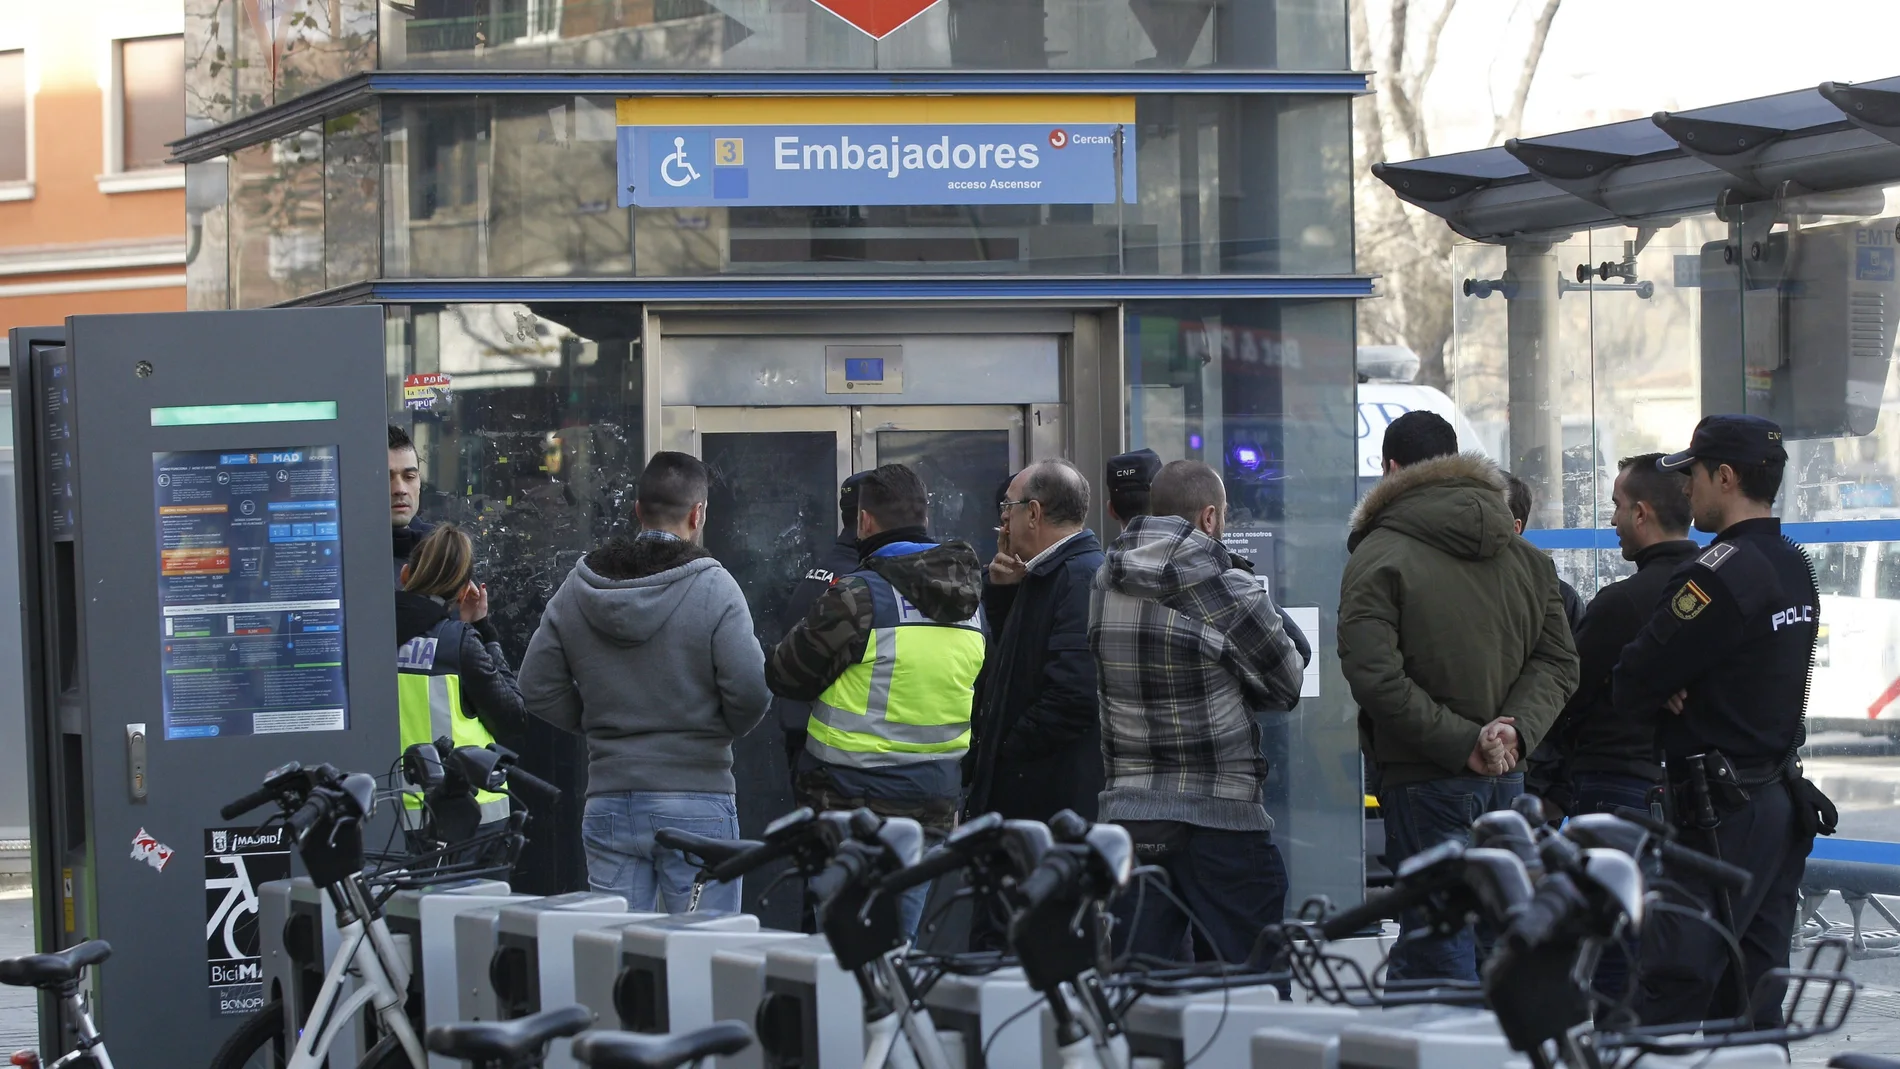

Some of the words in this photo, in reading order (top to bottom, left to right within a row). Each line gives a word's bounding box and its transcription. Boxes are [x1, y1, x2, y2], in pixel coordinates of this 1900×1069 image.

[1072, 133, 1126, 144] Cercans
[722, 140, 737, 163] 3
[774, 135, 1040, 179] Embajadores
[947, 180, 987, 190] acceso
[989, 178, 1042, 190] Ascensor
[1855, 229, 1895, 245] EMT
[272, 453, 300, 463] MAD
[1116, 468, 1136, 477] CNP
